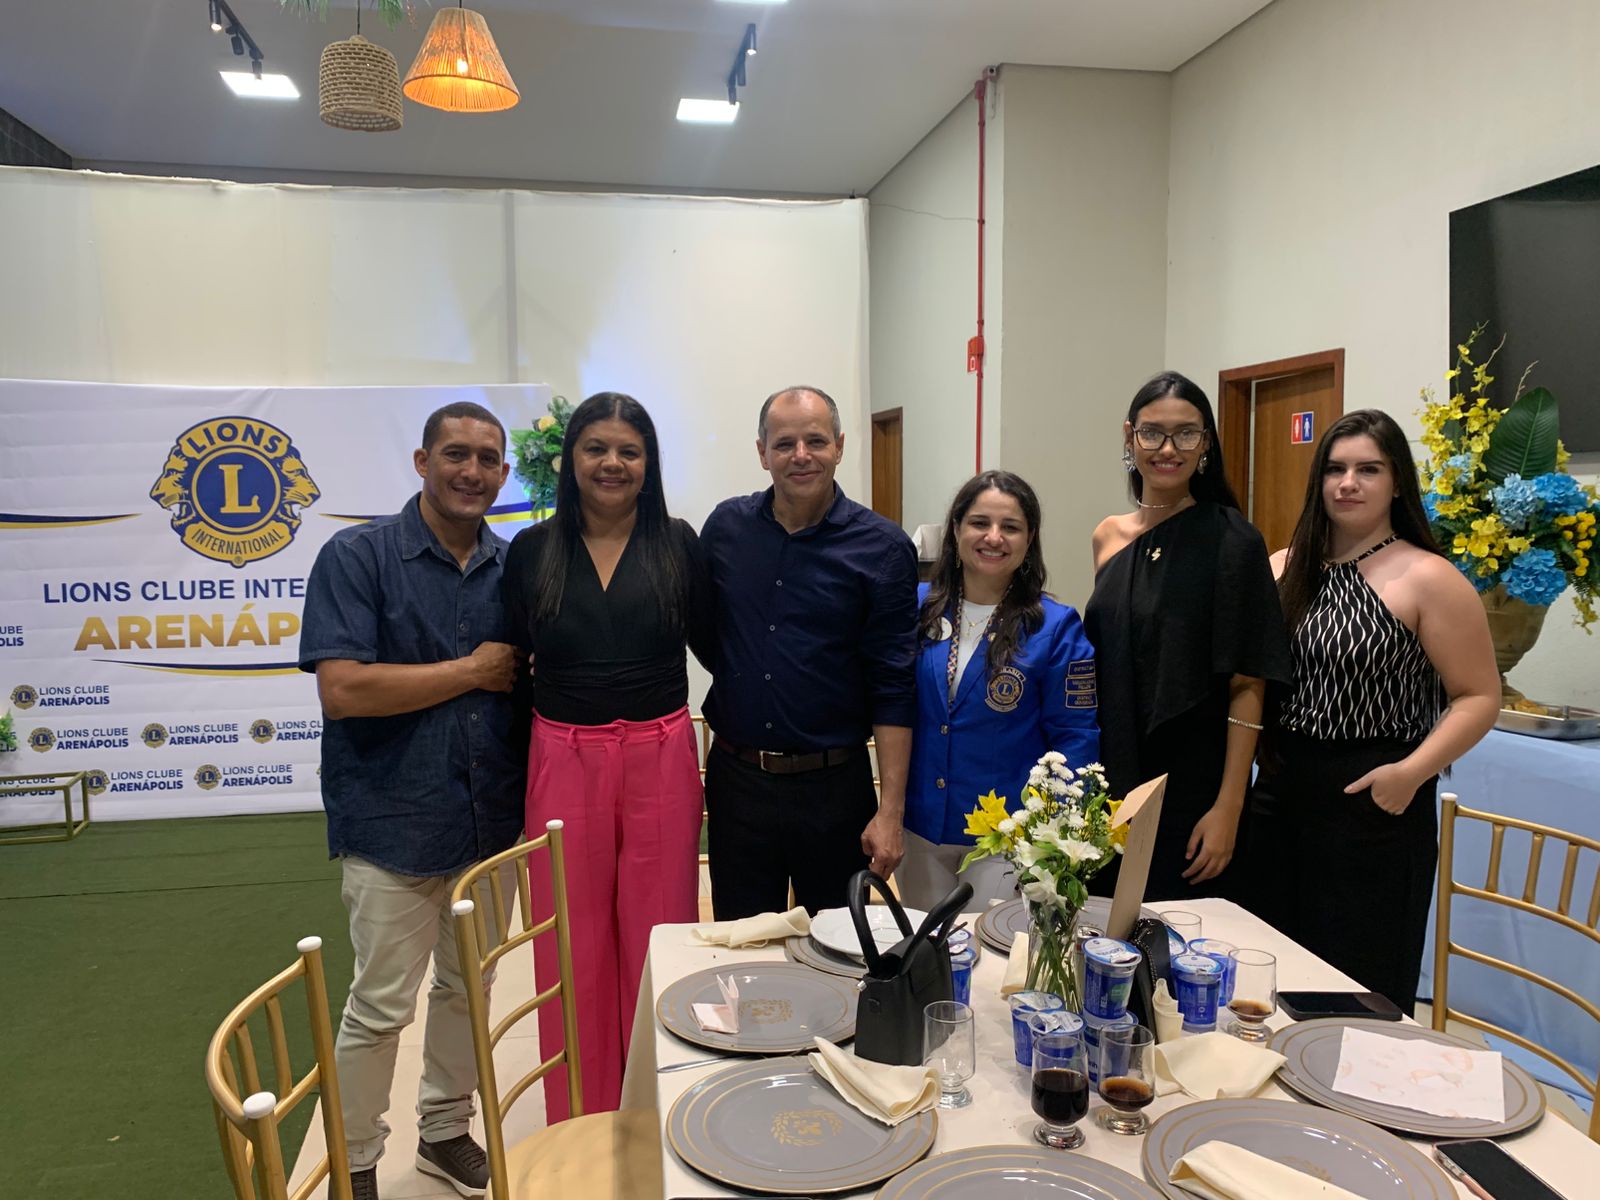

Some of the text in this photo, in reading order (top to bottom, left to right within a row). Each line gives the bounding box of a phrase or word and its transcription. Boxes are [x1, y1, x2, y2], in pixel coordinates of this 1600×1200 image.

[187, 422, 283, 454] LIONS
[218, 464, 261, 514] L
[191, 528, 285, 555] INTERNATIONAL
[43, 578, 305, 603] LIONS CLUBE INTE
[74, 603, 300, 651] ARENÁP
[39, 685, 110, 696] LIONS CLUBE
[39, 695, 110, 707] ARENÁPOLIS
[169, 723, 239, 734] LIONS CLUBE
[276, 720, 323, 730] LIONS CL
[57, 727, 128, 738] LIONS CLUBE
[276, 729, 323, 741] ARENÁP
[57, 738, 129, 750] ARENÁPOLIS
[169, 733, 239, 745] ARENÁPOLIS
[110, 769, 183, 781] LIONS CLUBE
[222, 764, 293, 775] LIONS CLUBE
[110, 780, 184, 793] ARENÁPOLIS
[222, 774, 293, 787] ARENÁPOLIS
